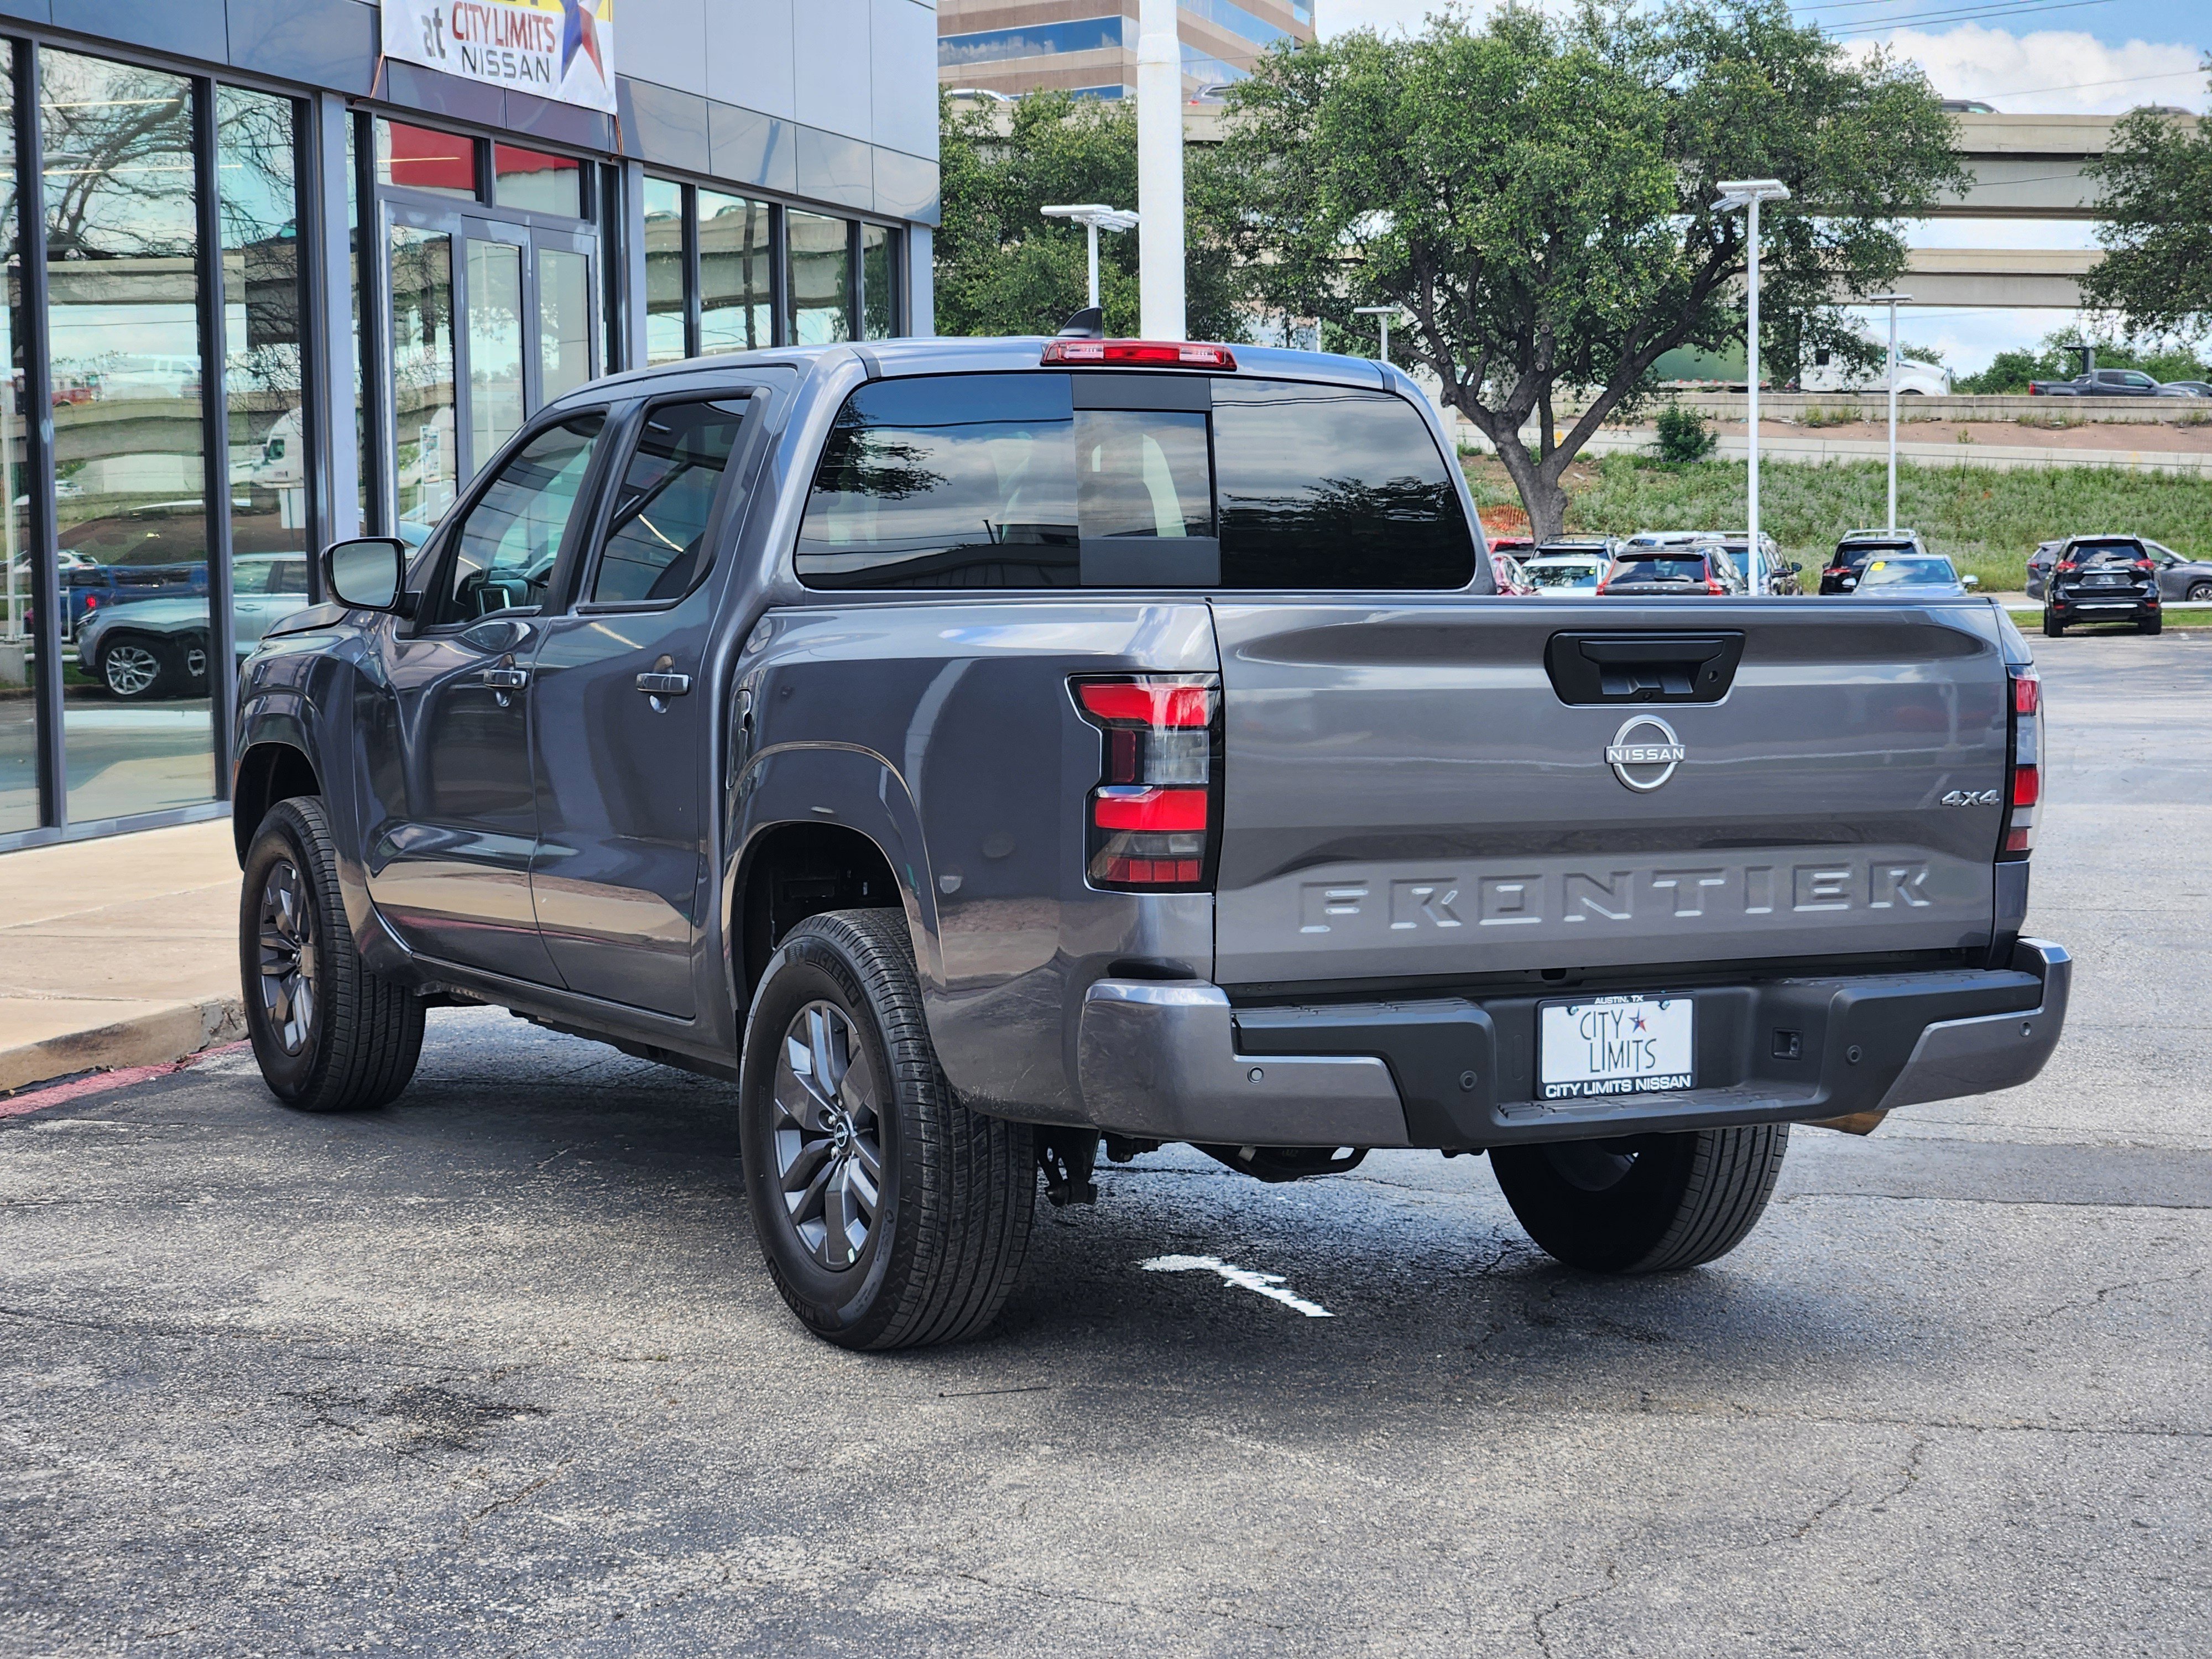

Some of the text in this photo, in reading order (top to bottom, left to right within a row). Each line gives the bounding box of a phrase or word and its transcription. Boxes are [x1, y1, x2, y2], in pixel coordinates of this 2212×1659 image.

[421, 7, 446, 59] at
[461, 45, 551, 84] NISSAN
[1609, 748, 1685, 761] NISSAN
[1299, 859, 1932, 933] FRONTIER
[1631, 994, 1644, 1003] TX
[1580, 1009, 1624, 1042] CITY
[1590, 1037, 1657, 1073] LIMITS
[1545, 1075, 1692, 1098] CITY LIMITS NISSAN
